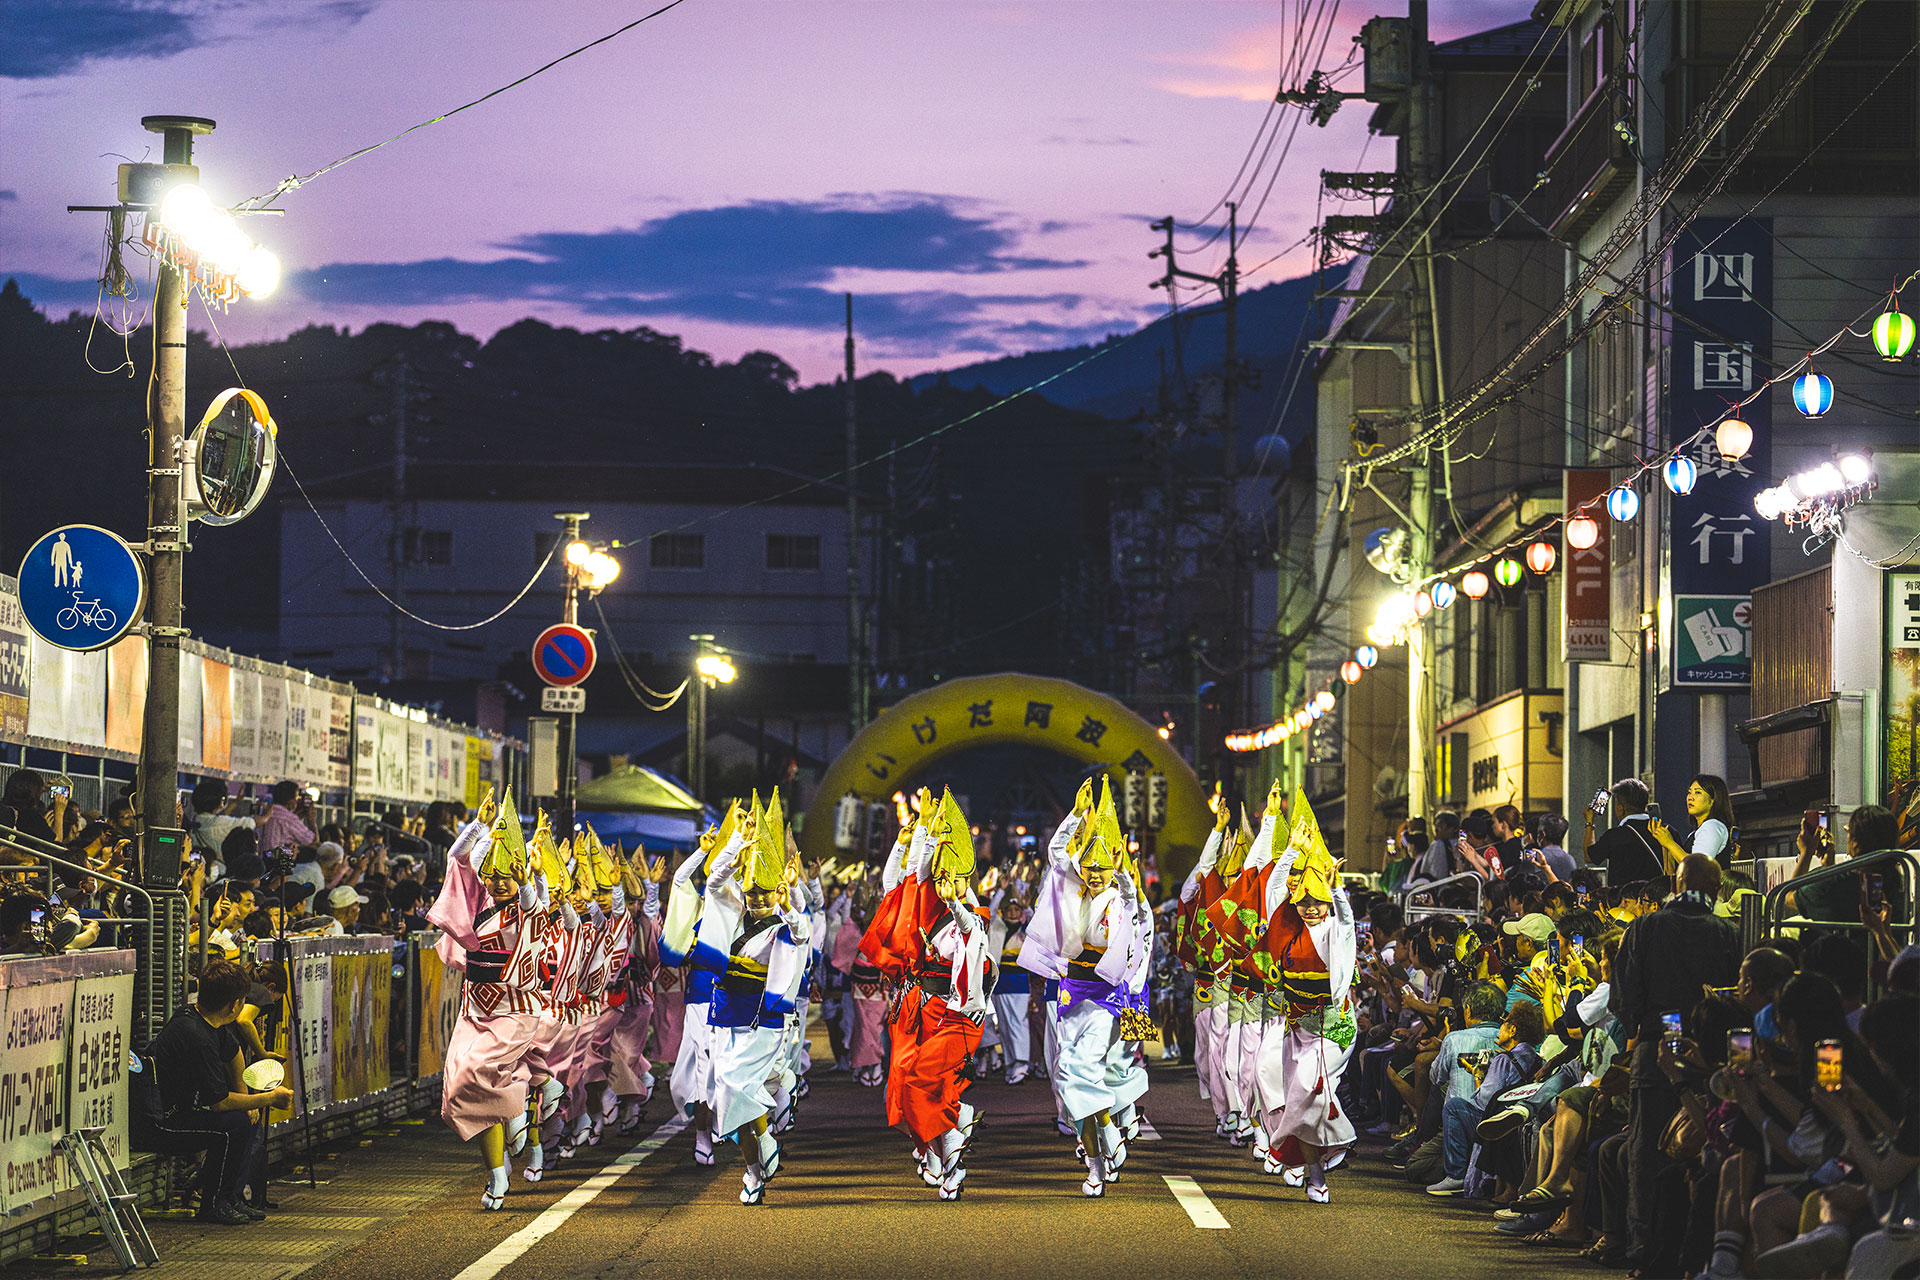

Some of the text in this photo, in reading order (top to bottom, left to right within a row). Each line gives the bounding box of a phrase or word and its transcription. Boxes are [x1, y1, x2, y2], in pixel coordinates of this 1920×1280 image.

[1573, 501, 1605, 597] LXIL
[1570, 633, 1606, 646] LIXIL
[1701, 625, 1713, 647] CARD
[79, 1025, 121, 1093] 白地温泉
